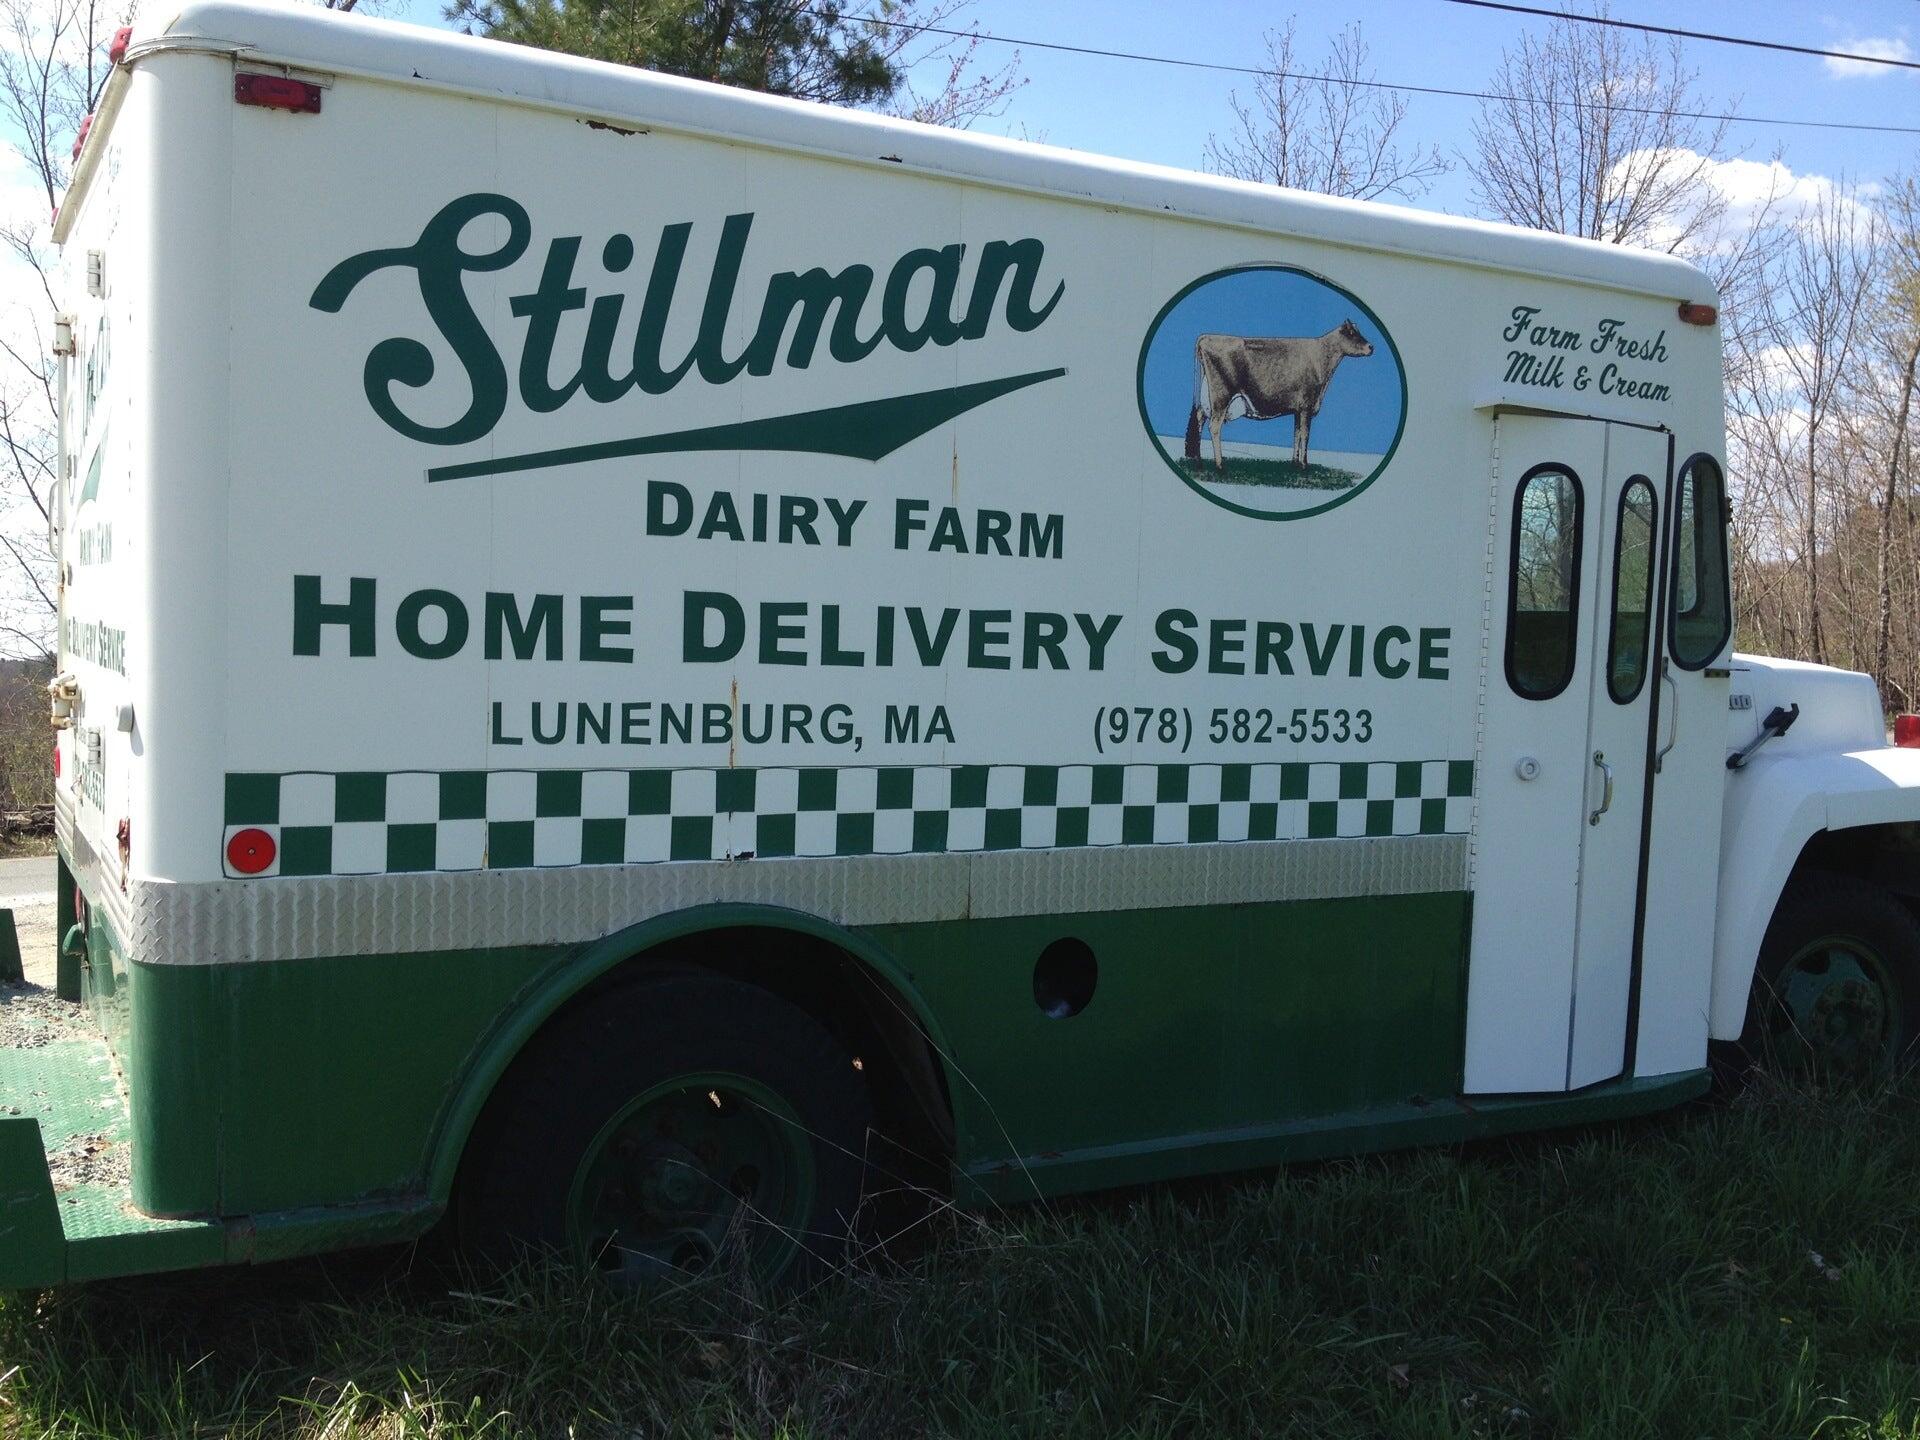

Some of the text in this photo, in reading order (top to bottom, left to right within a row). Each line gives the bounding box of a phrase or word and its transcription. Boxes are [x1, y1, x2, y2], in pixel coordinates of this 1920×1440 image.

[308, 192, 1066, 446] Stillman
[1502, 305, 1669, 364] Farm Fresh
[1502, 350, 1672, 402] Milk & Cream
[646, 479, 1064, 560] DAIRY FARM
[292, 574, 1451, 681] HOME DELIVERY SERVICE
[491, 701, 956, 754] LUNENBURG, MA
[1094, 706, 1373, 754] (978) 582-5533
